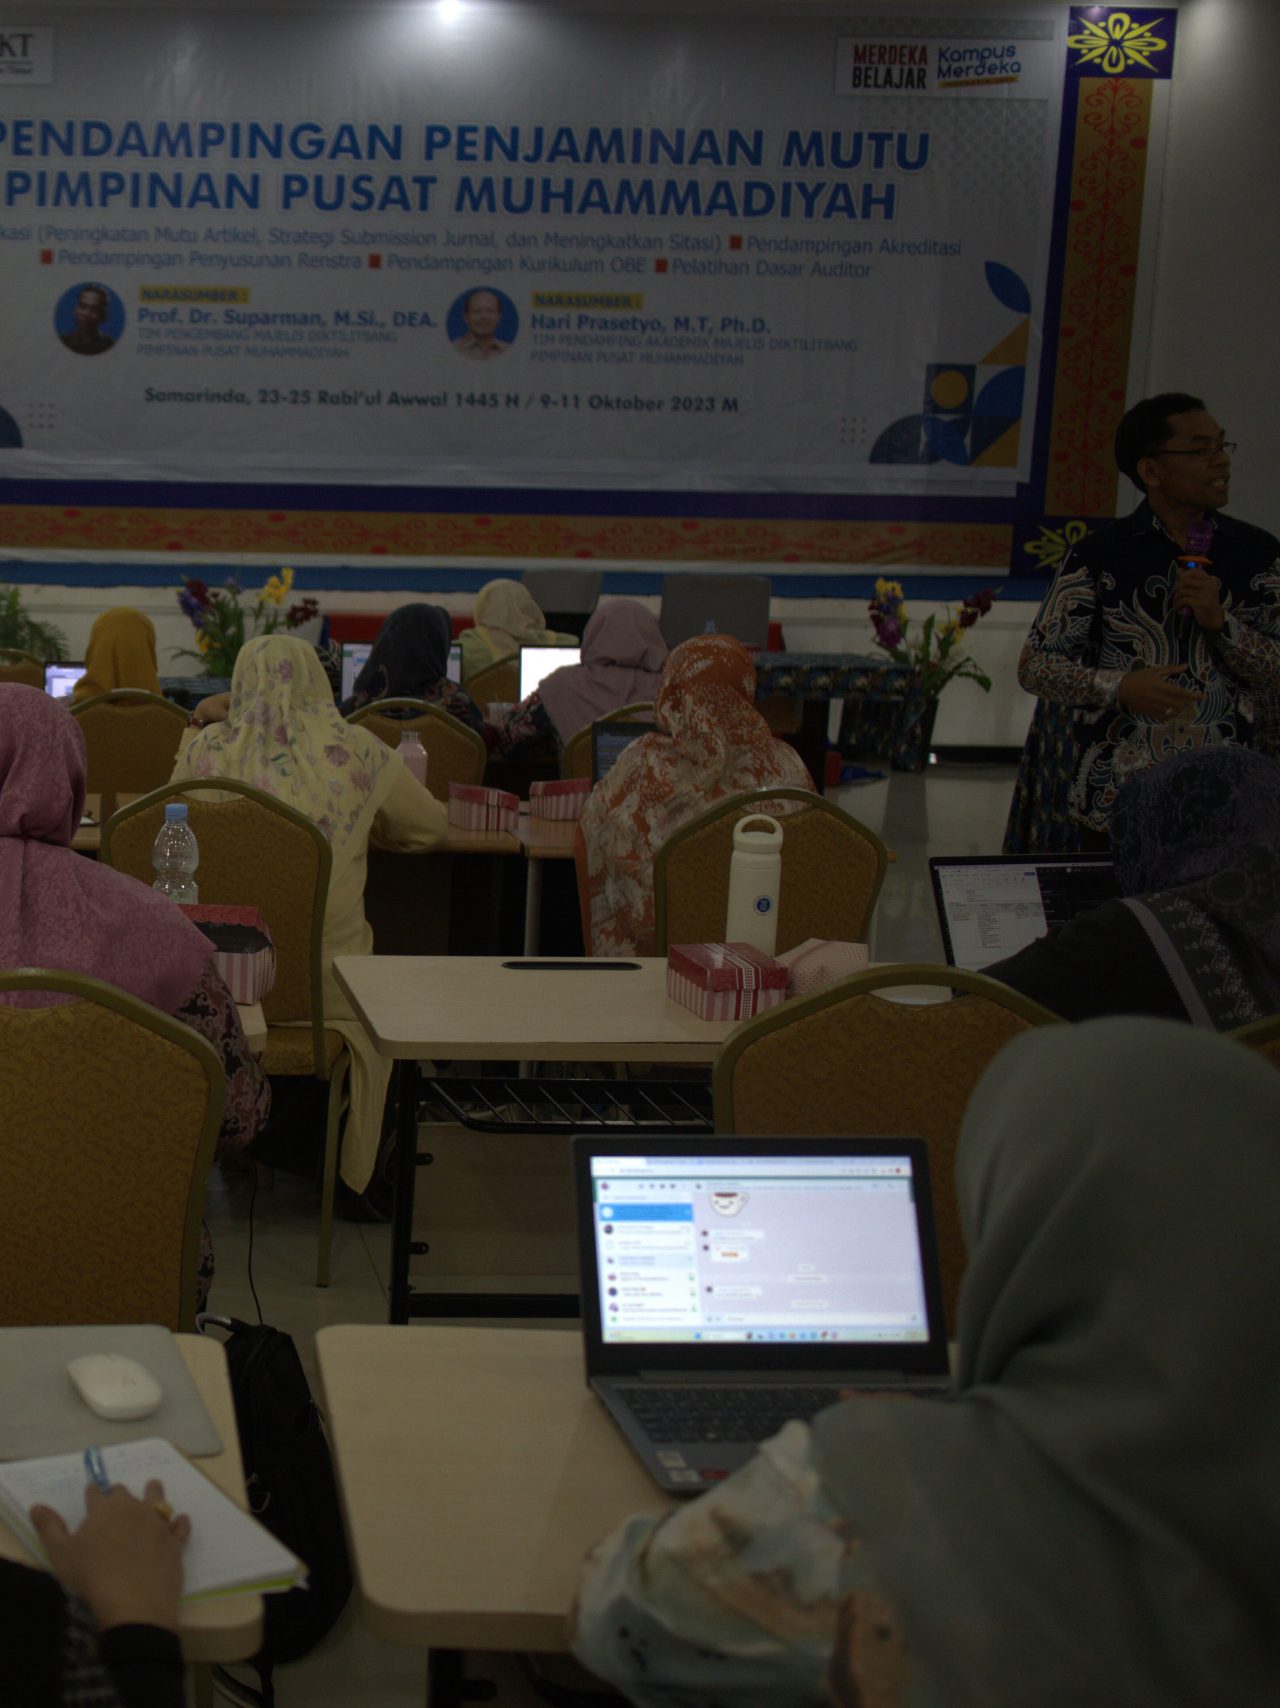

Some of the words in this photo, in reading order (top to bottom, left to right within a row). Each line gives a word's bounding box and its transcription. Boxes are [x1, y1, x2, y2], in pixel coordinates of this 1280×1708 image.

[853, 44, 928, 65] MERDEKA
[938, 45, 1016, 64] Kampus
[852, 66, 927, 89] BELAJAR
[937, 60, 1022, 79] Merdeka
[425, 125, 764, 168] PENJAMINAN
[782, 131, 930, 171] MUTU
[6, 170, 260, 209] PIMPINAN
[282, 174, 437, 212] PUSAT
[455, 177, 895, 220] MUHAMMADIYAH
[37, 225, 149, 244] (Peningkatan
[155, 227, 197, 242] Mutu
[203, 227, 261, 245] Artikel,
[270, 228, 335, 247] Strategi
[341, 228, 436, 245] Submission
[442, 230, 498, 248] Jurnal,
[505, 232, 538, 247] dan
[544, 232, 663, 251] Meningkatkan
[670, 233, 723, 254] Sitasi)
[747, 235, 873, 257] Pendampingan
[879, 238, 962, 256] Akreditasi
[58, 249, 183, 269] Pendampingan
[190, 251, 291, 271] Penyusunan
[298, 252, 362, 269] Renstra
[388, 254, 513, 274] Pendampingan
[520, 256, 604, 273] Kurikulum
[610, 257, 647, 273] OBE
[672, 258, 749, 275] Pelatihan
[756, 259, 804, 276] Dasar
[812, 260, 874, 278] Auditor
[137, 308, 183, 325] Prof.
[189, 309, 217, 325] Dr.
[223, 309, 327, 328] Suparman,
[392, 312, 437, 328] DEA.
[531, 314, 571, 331] Hari
[577, 315, 668, 335] Prasetyo,
[674, 317, 714, 334] M.T,
[721, 318, 771, 334] Ph.D.
[144, 387, 251, 405] Samarinda,
[258, 389, 311, 404] 23-25
[387, 391, 448, 407] Awwal
[455, 393, 499, 408] 1445
[505, 394, 521, 408] H
[539, 394, 581, 409] 9-11
[588, 394, 664, 411] Oktober
[671, 396, 716, 411] 2023
[721, 398, 739, 412] M
